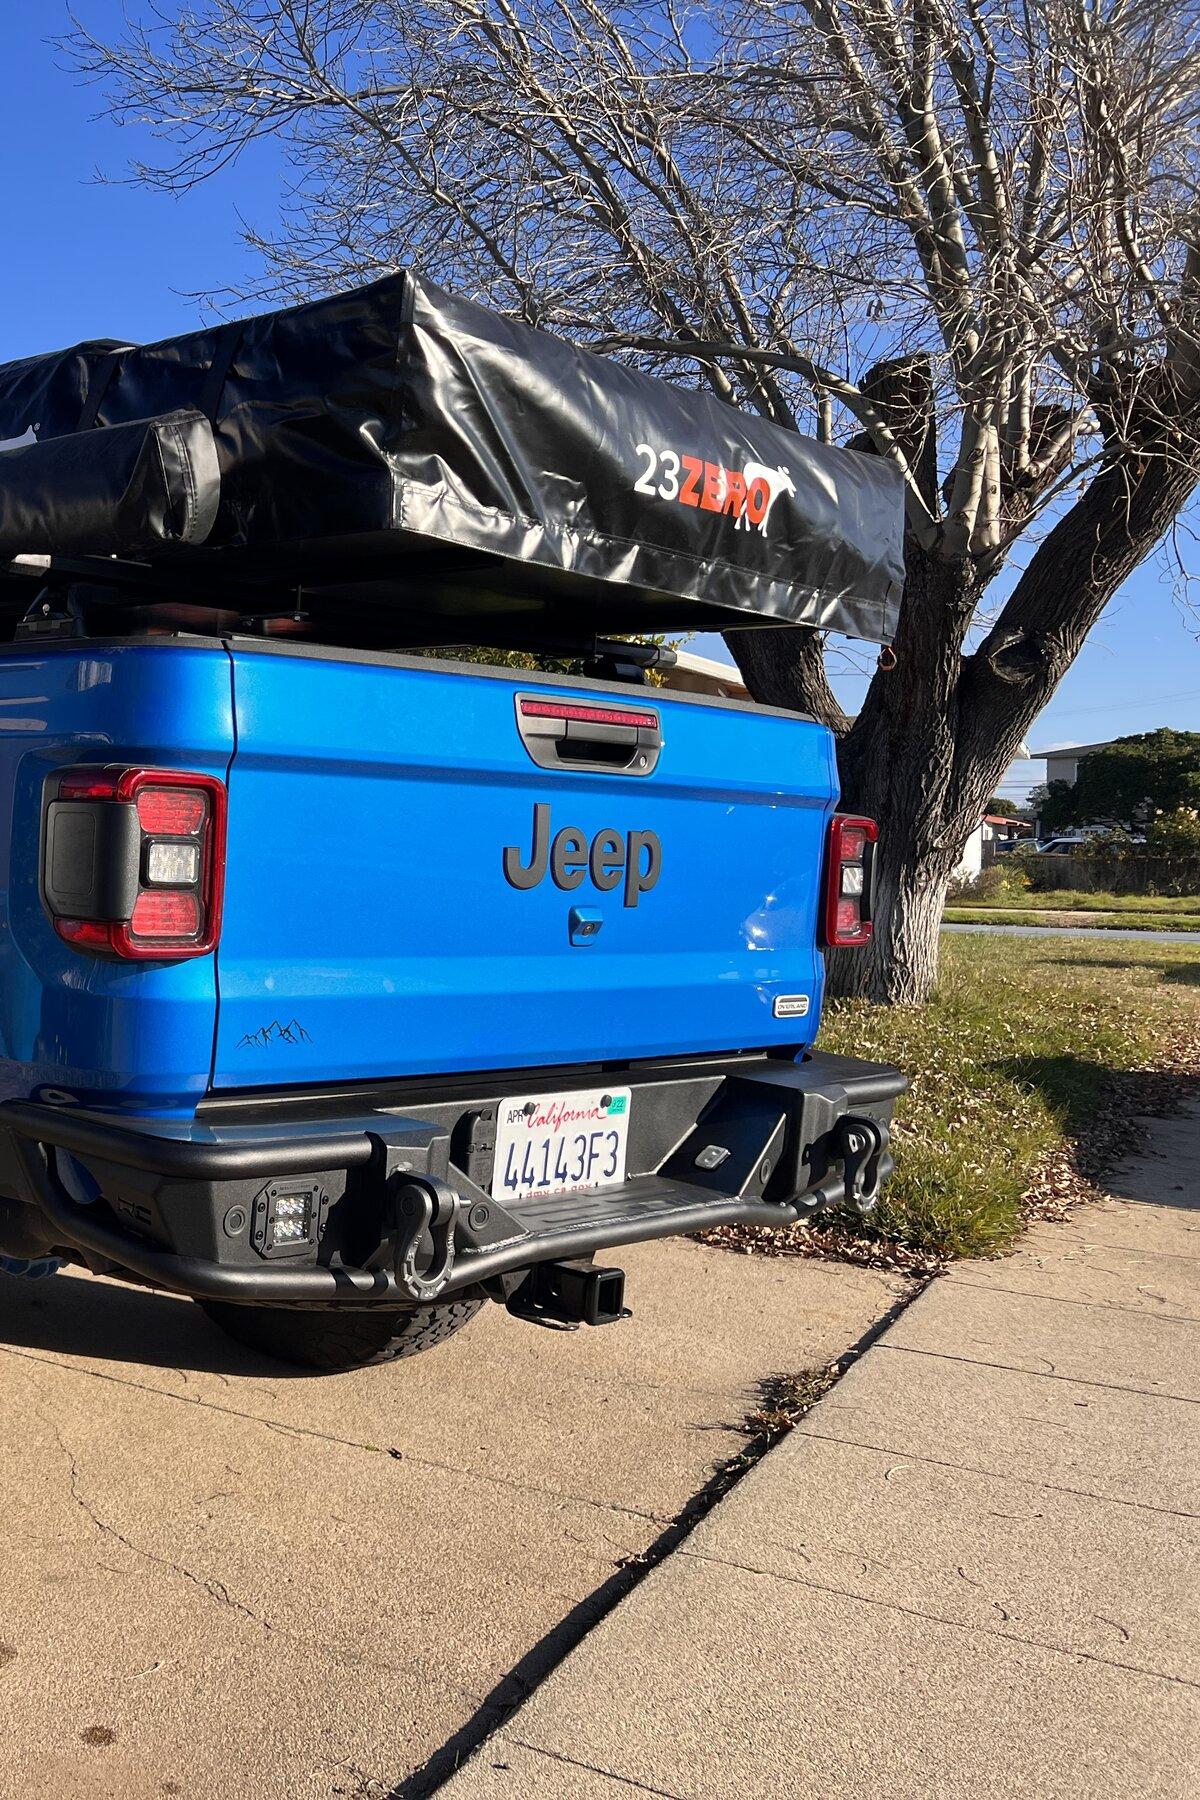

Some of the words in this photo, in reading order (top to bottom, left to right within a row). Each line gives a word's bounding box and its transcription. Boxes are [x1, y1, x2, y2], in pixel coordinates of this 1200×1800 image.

[633, 443, 771, 524] 23ZERO
[503, 802, 662, 908] Jeep
[507, 1108, 525, 1124] APR
[527, 1101, 606, 1133] California
[504, 1130, 619, 1192] 44143F3
